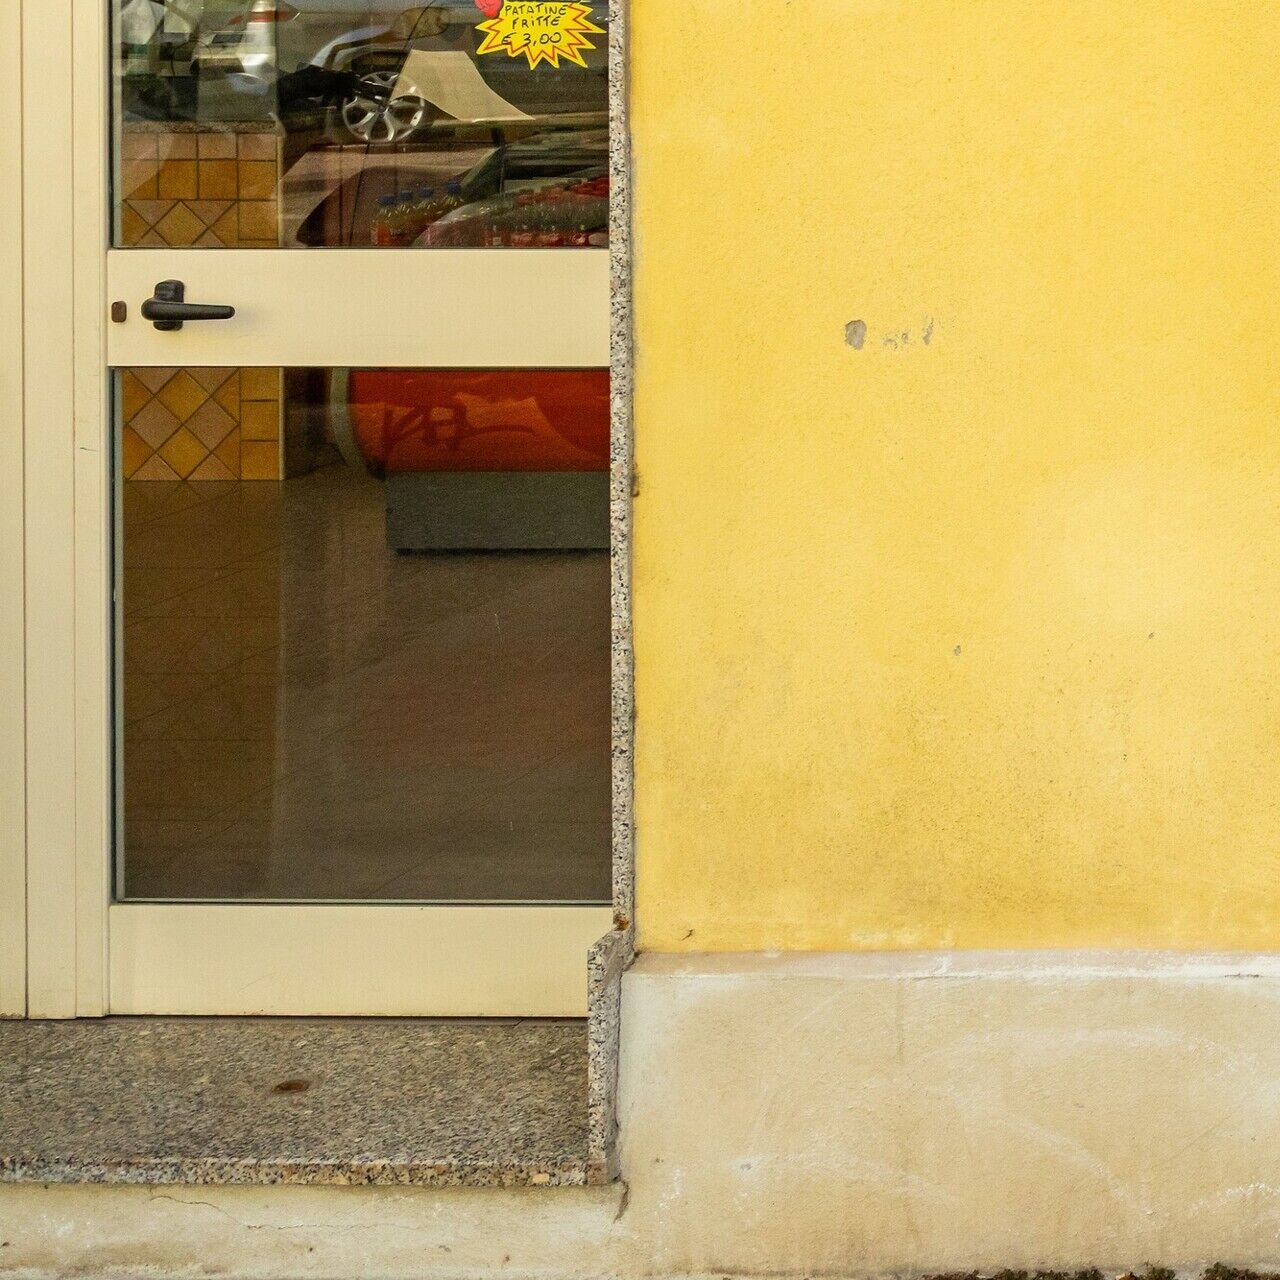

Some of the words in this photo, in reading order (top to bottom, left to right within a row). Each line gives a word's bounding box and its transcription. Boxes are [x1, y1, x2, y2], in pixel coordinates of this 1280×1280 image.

[505, 3, 568, 16] PATATINE
[501, 32, 517, 45] €
[522, 31, 562, 47] 3,00
